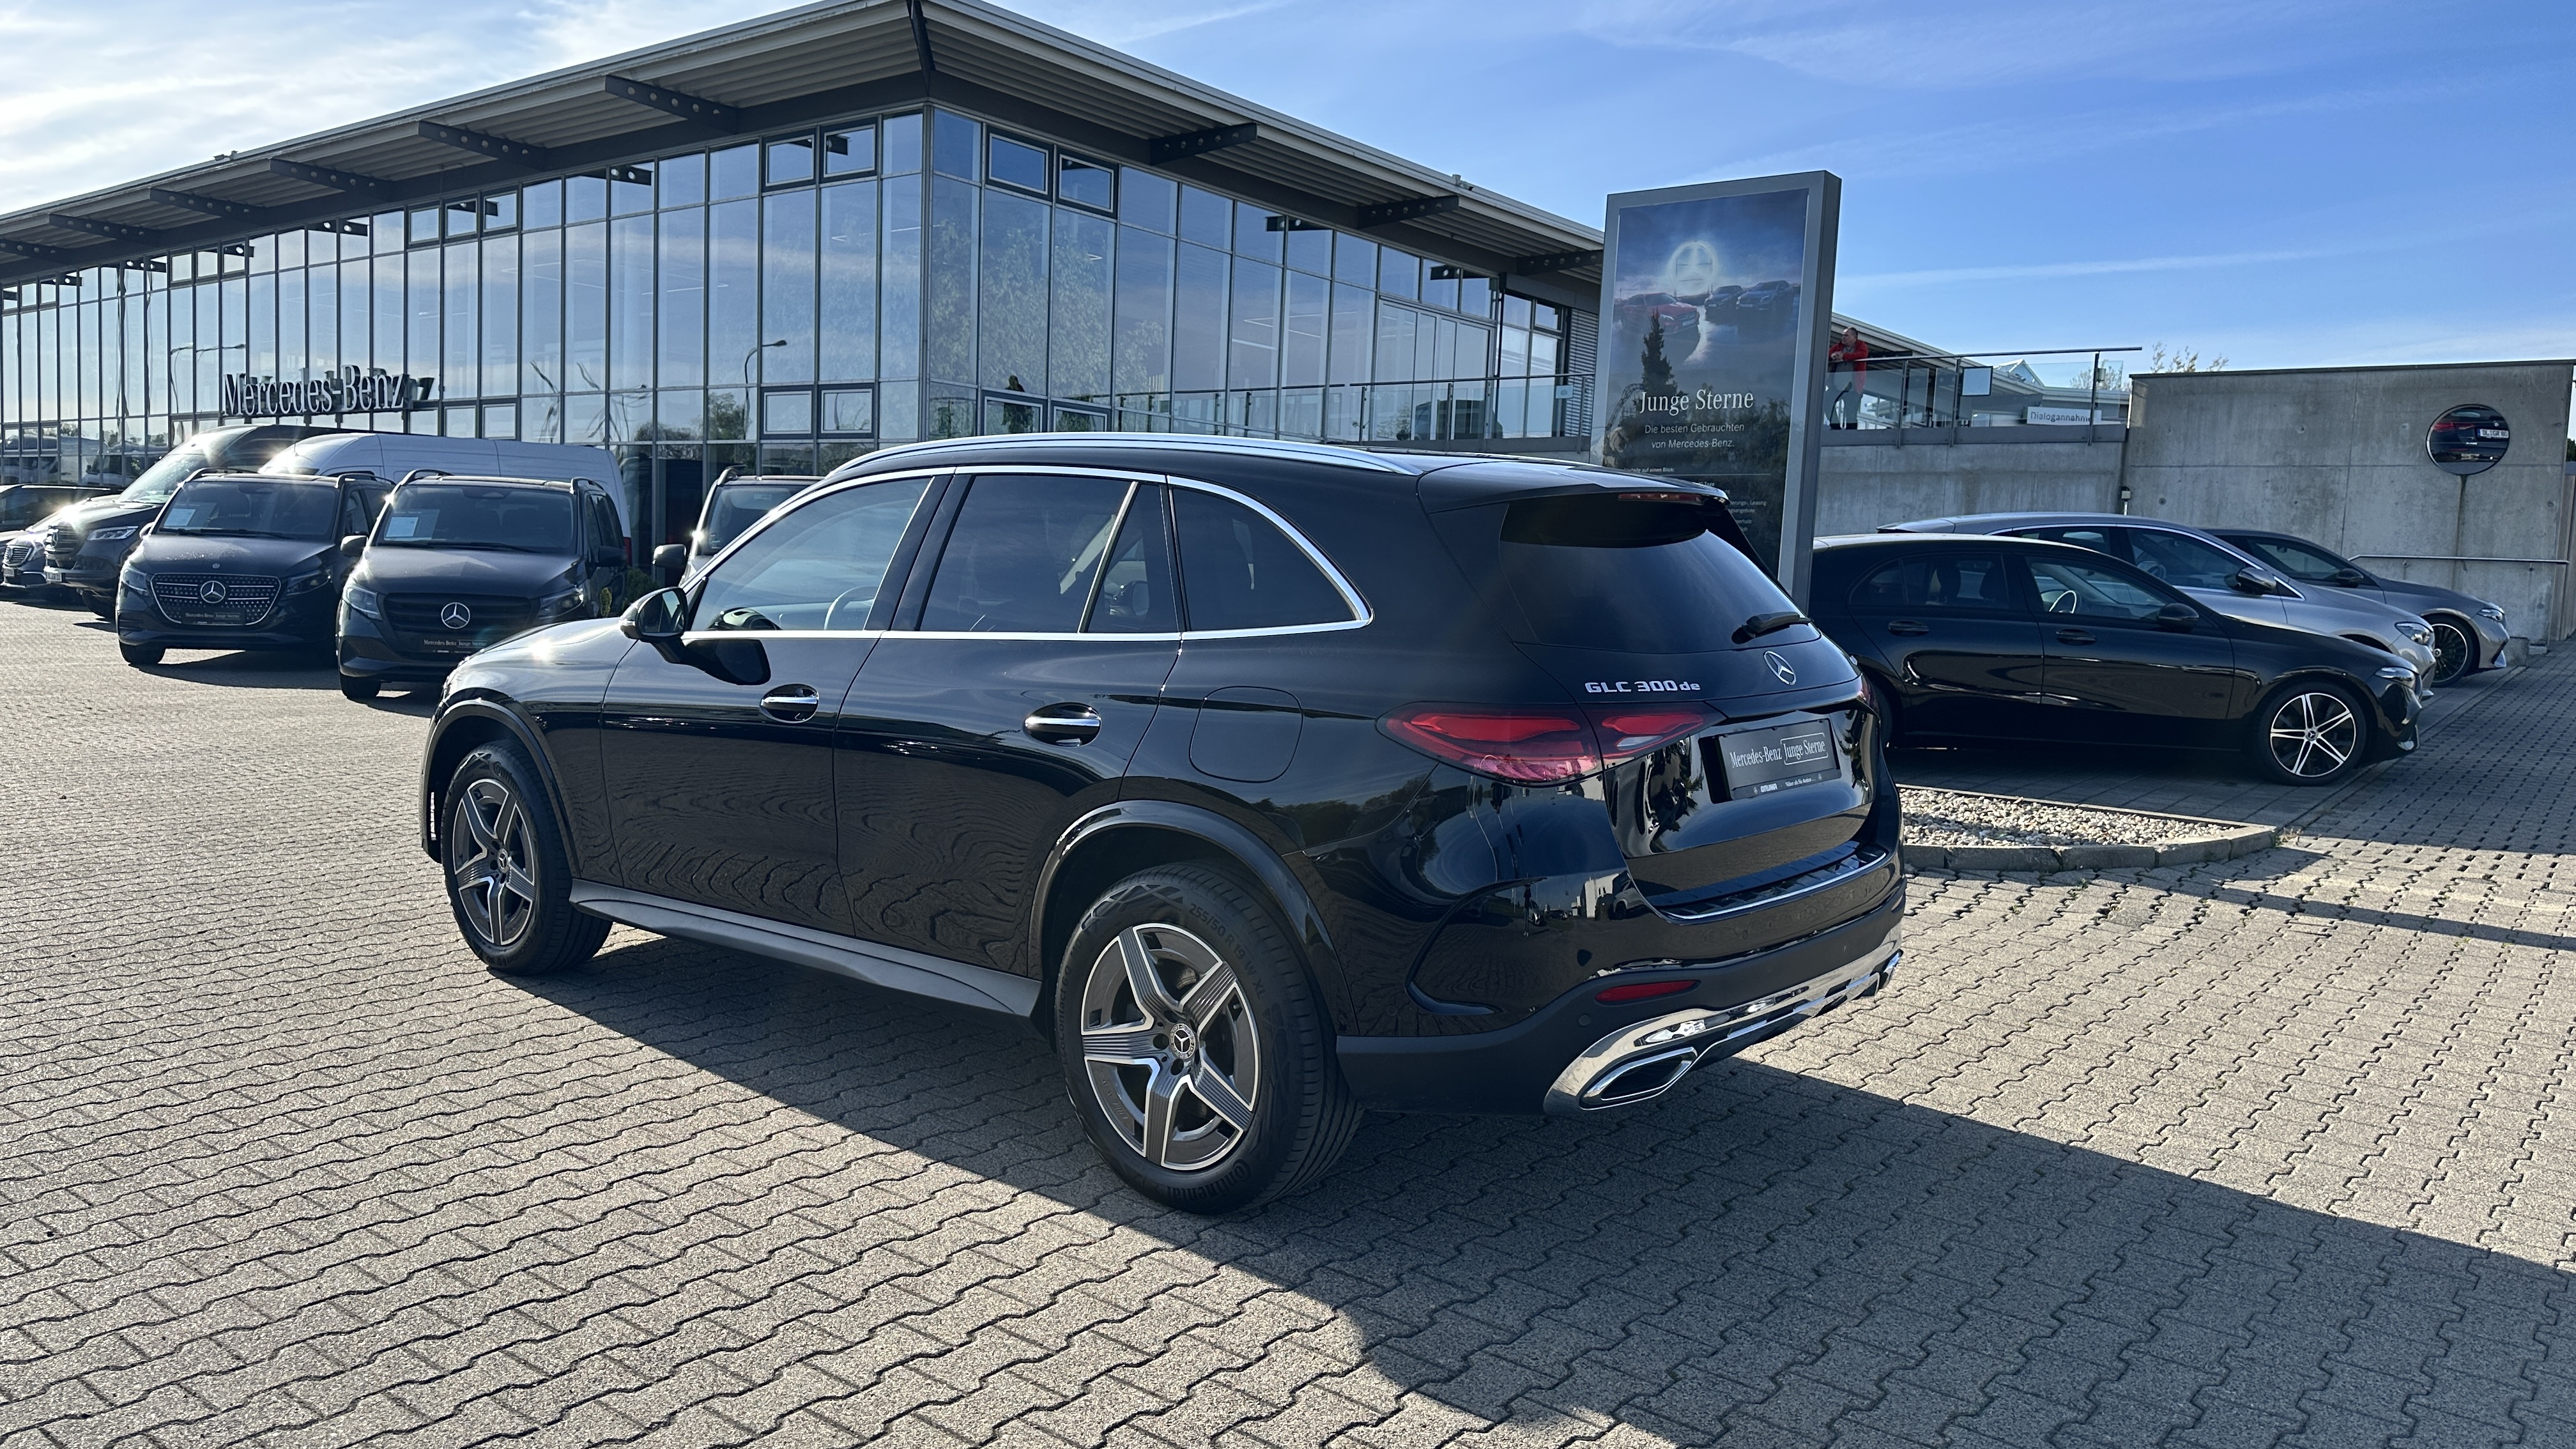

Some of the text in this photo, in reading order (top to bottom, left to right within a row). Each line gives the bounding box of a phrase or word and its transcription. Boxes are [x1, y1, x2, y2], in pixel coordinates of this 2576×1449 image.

[224, 364, 404, 416] Mercedes-Benz
[1639, 389, 1754, 416] Junge Sterne
[1644, 422, 1745, 434] Die besten Gebrauchten
[1668, 438, 1735, 448] Mercedes-Benz.
[1584, 681, 1632, 693] GLC
[1729, 739, 1826, 769] Mercedes-Benz Junge Sterne
[1189, 903, 1266, 1000] 255/50 R 19 W XL
[1166, 1158, 1252, 1201] Continental
